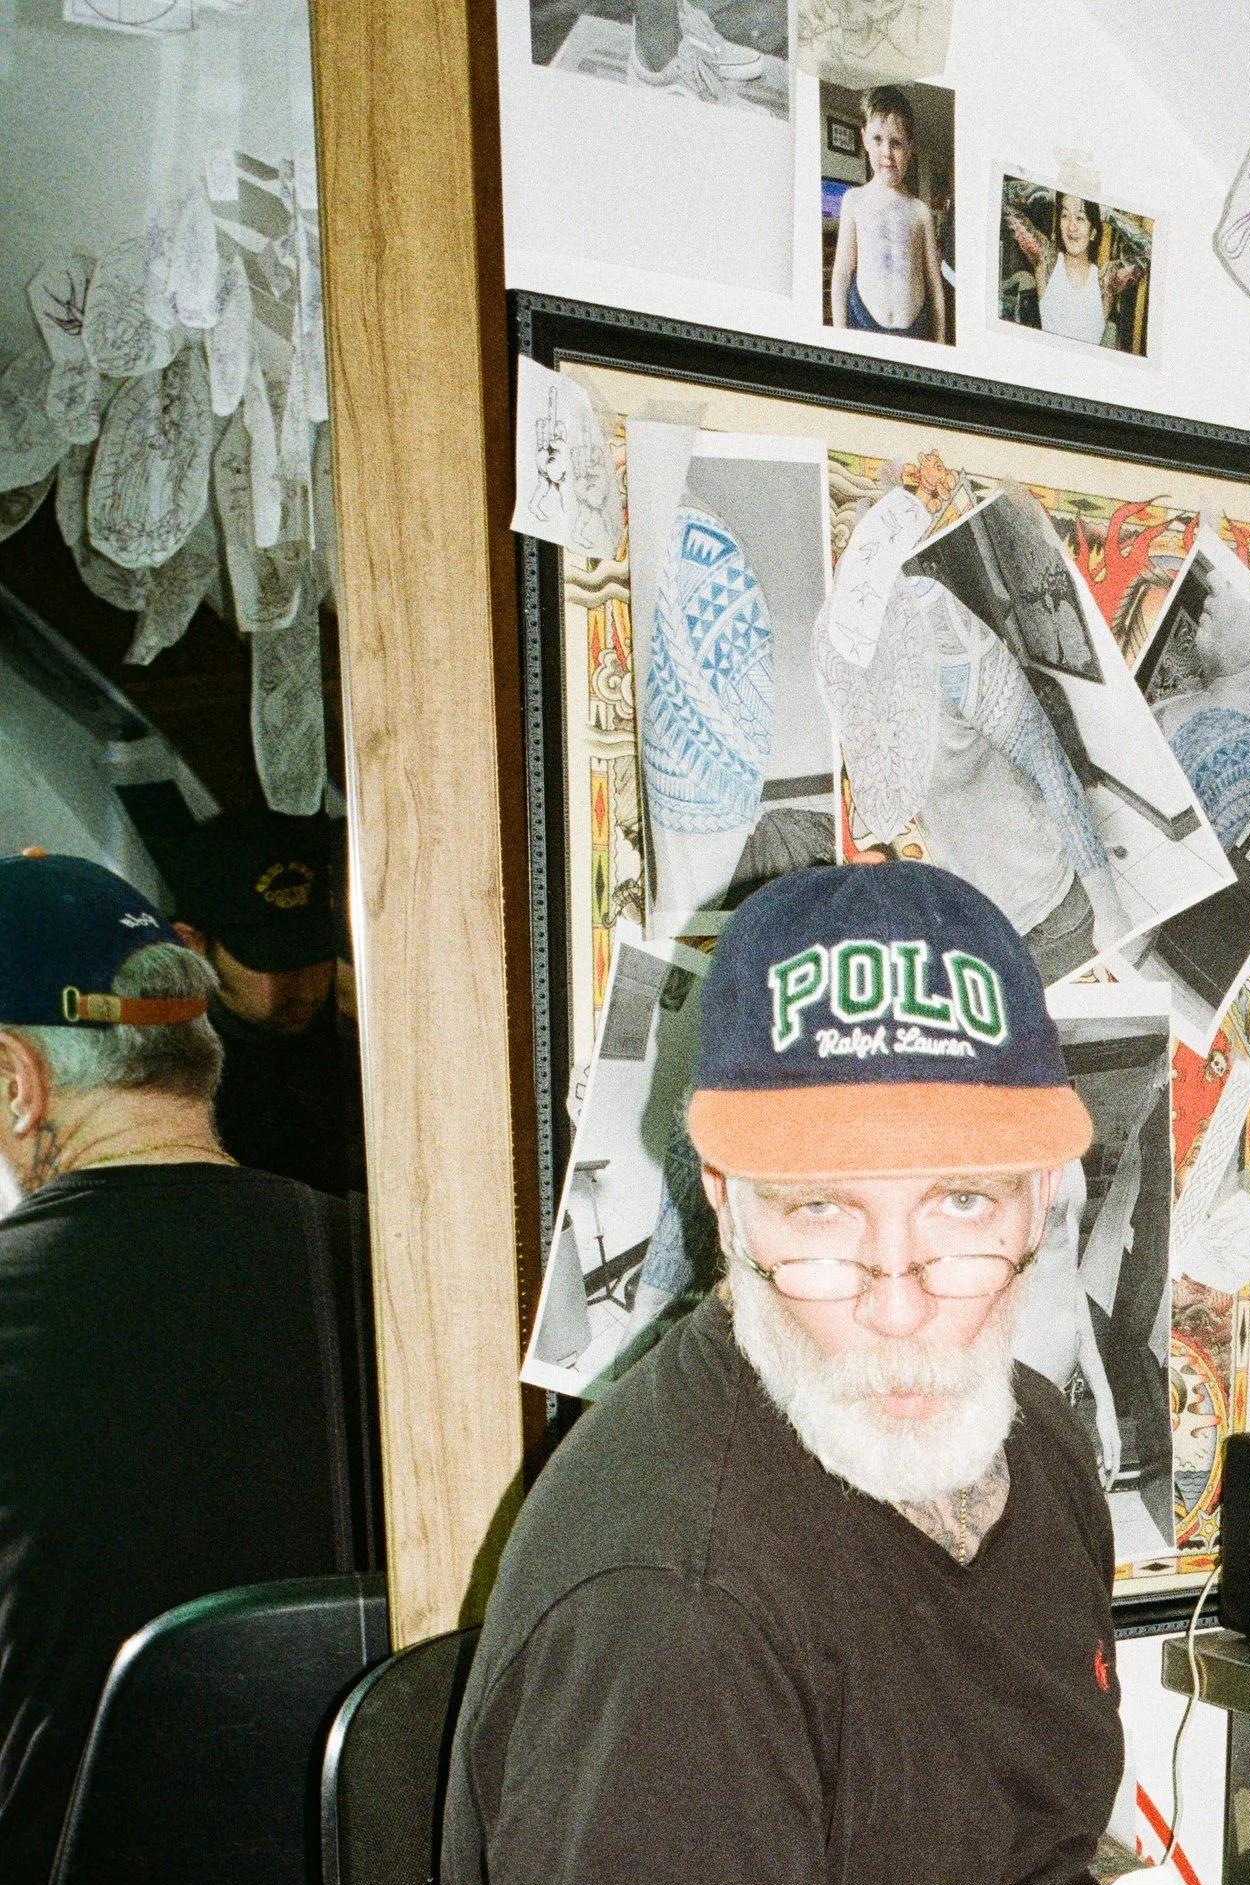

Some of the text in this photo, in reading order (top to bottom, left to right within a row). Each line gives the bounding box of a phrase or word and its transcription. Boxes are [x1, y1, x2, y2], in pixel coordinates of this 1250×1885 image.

[767, 938, 1008, 1053] POLO
[815, 1027, 976, 1060] Ralph Lauren
